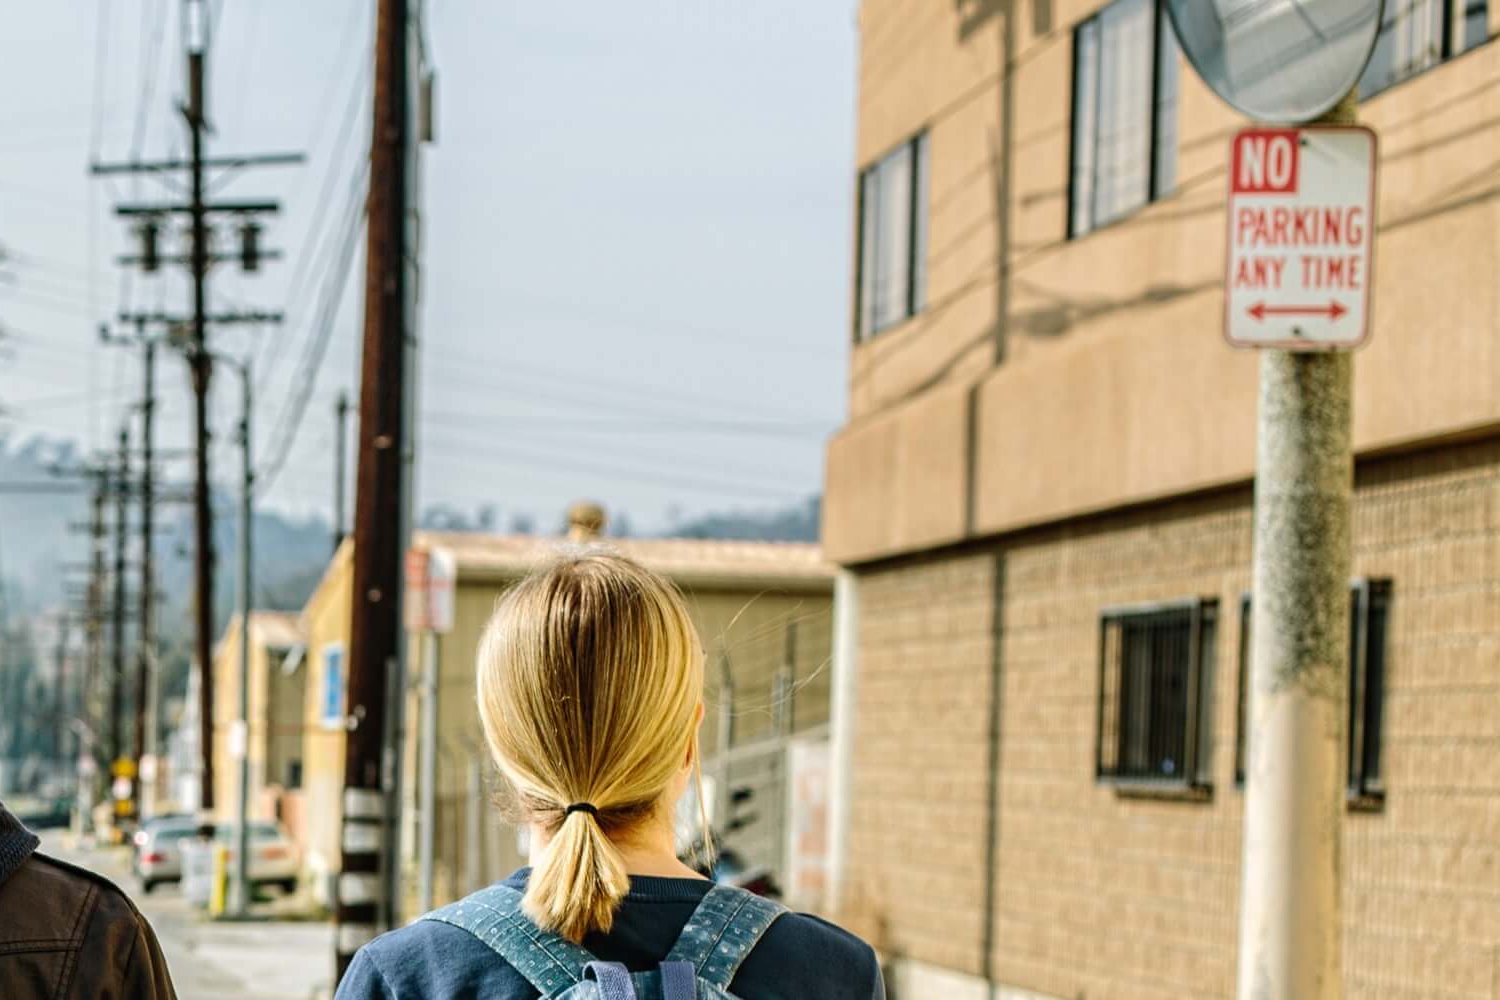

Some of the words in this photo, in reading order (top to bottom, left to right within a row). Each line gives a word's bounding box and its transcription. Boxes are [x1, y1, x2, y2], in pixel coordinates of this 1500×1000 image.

[1238, 137, 1293, 189] NO
[1236, 206, 1364, 247] PARKING
[1235, 255, 1285, 289] ANY
[1301, 255, 1361, 290] TIME
